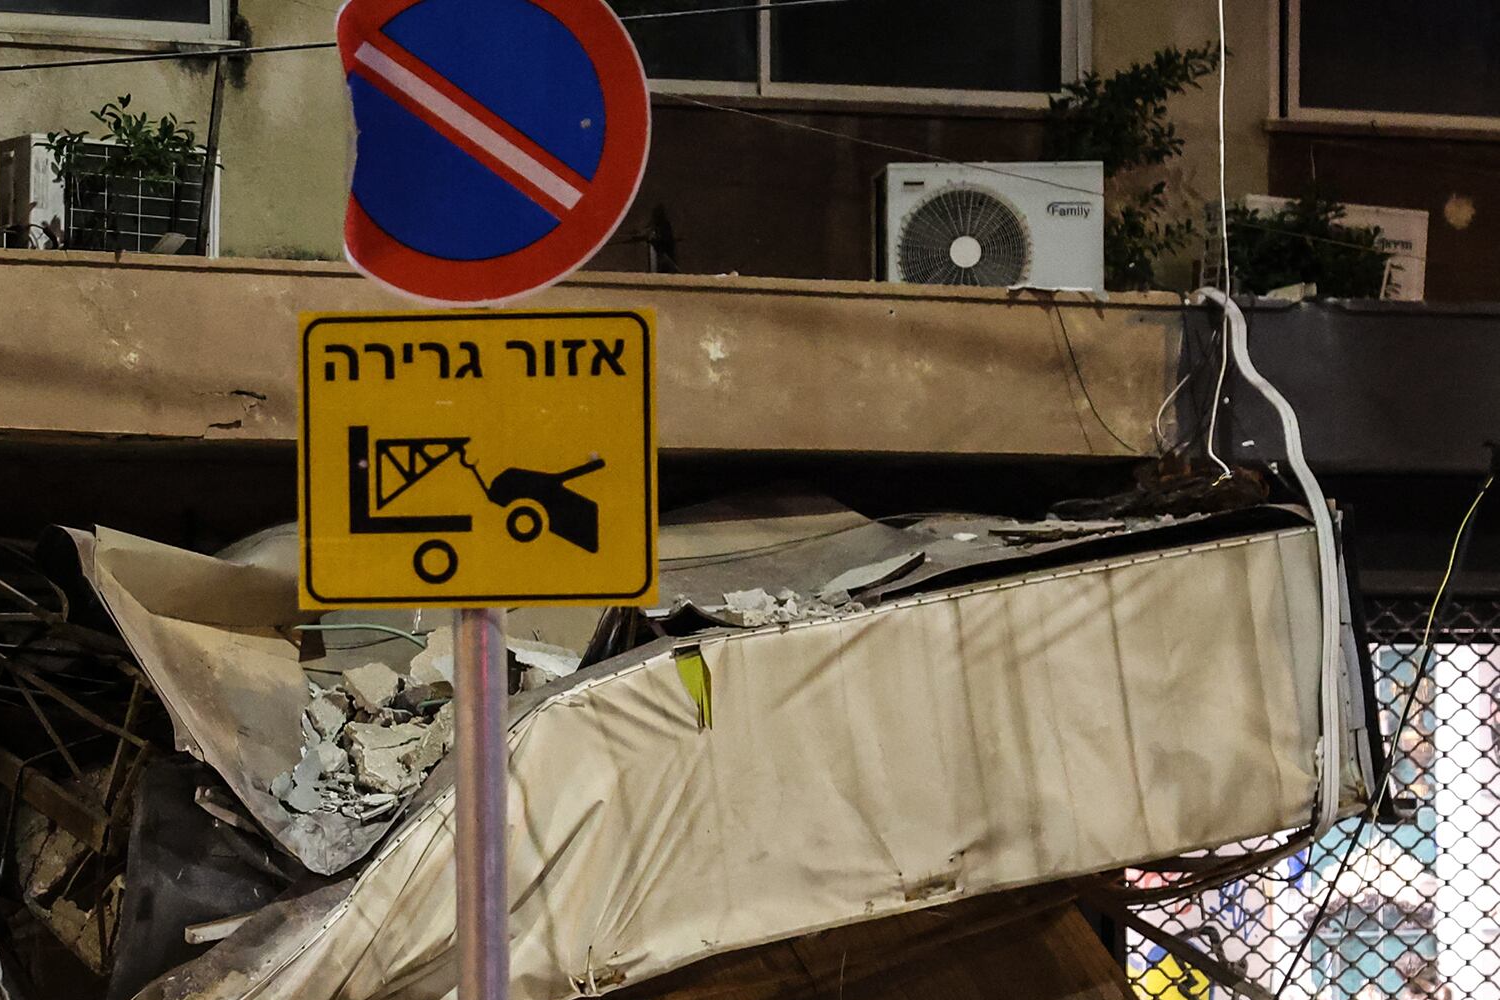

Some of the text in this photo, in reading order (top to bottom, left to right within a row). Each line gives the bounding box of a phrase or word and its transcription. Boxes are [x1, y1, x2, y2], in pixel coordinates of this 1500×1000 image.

[1050, 203, 1091, 219] Family
[324, 338, 627, 382] אזור גרירה
